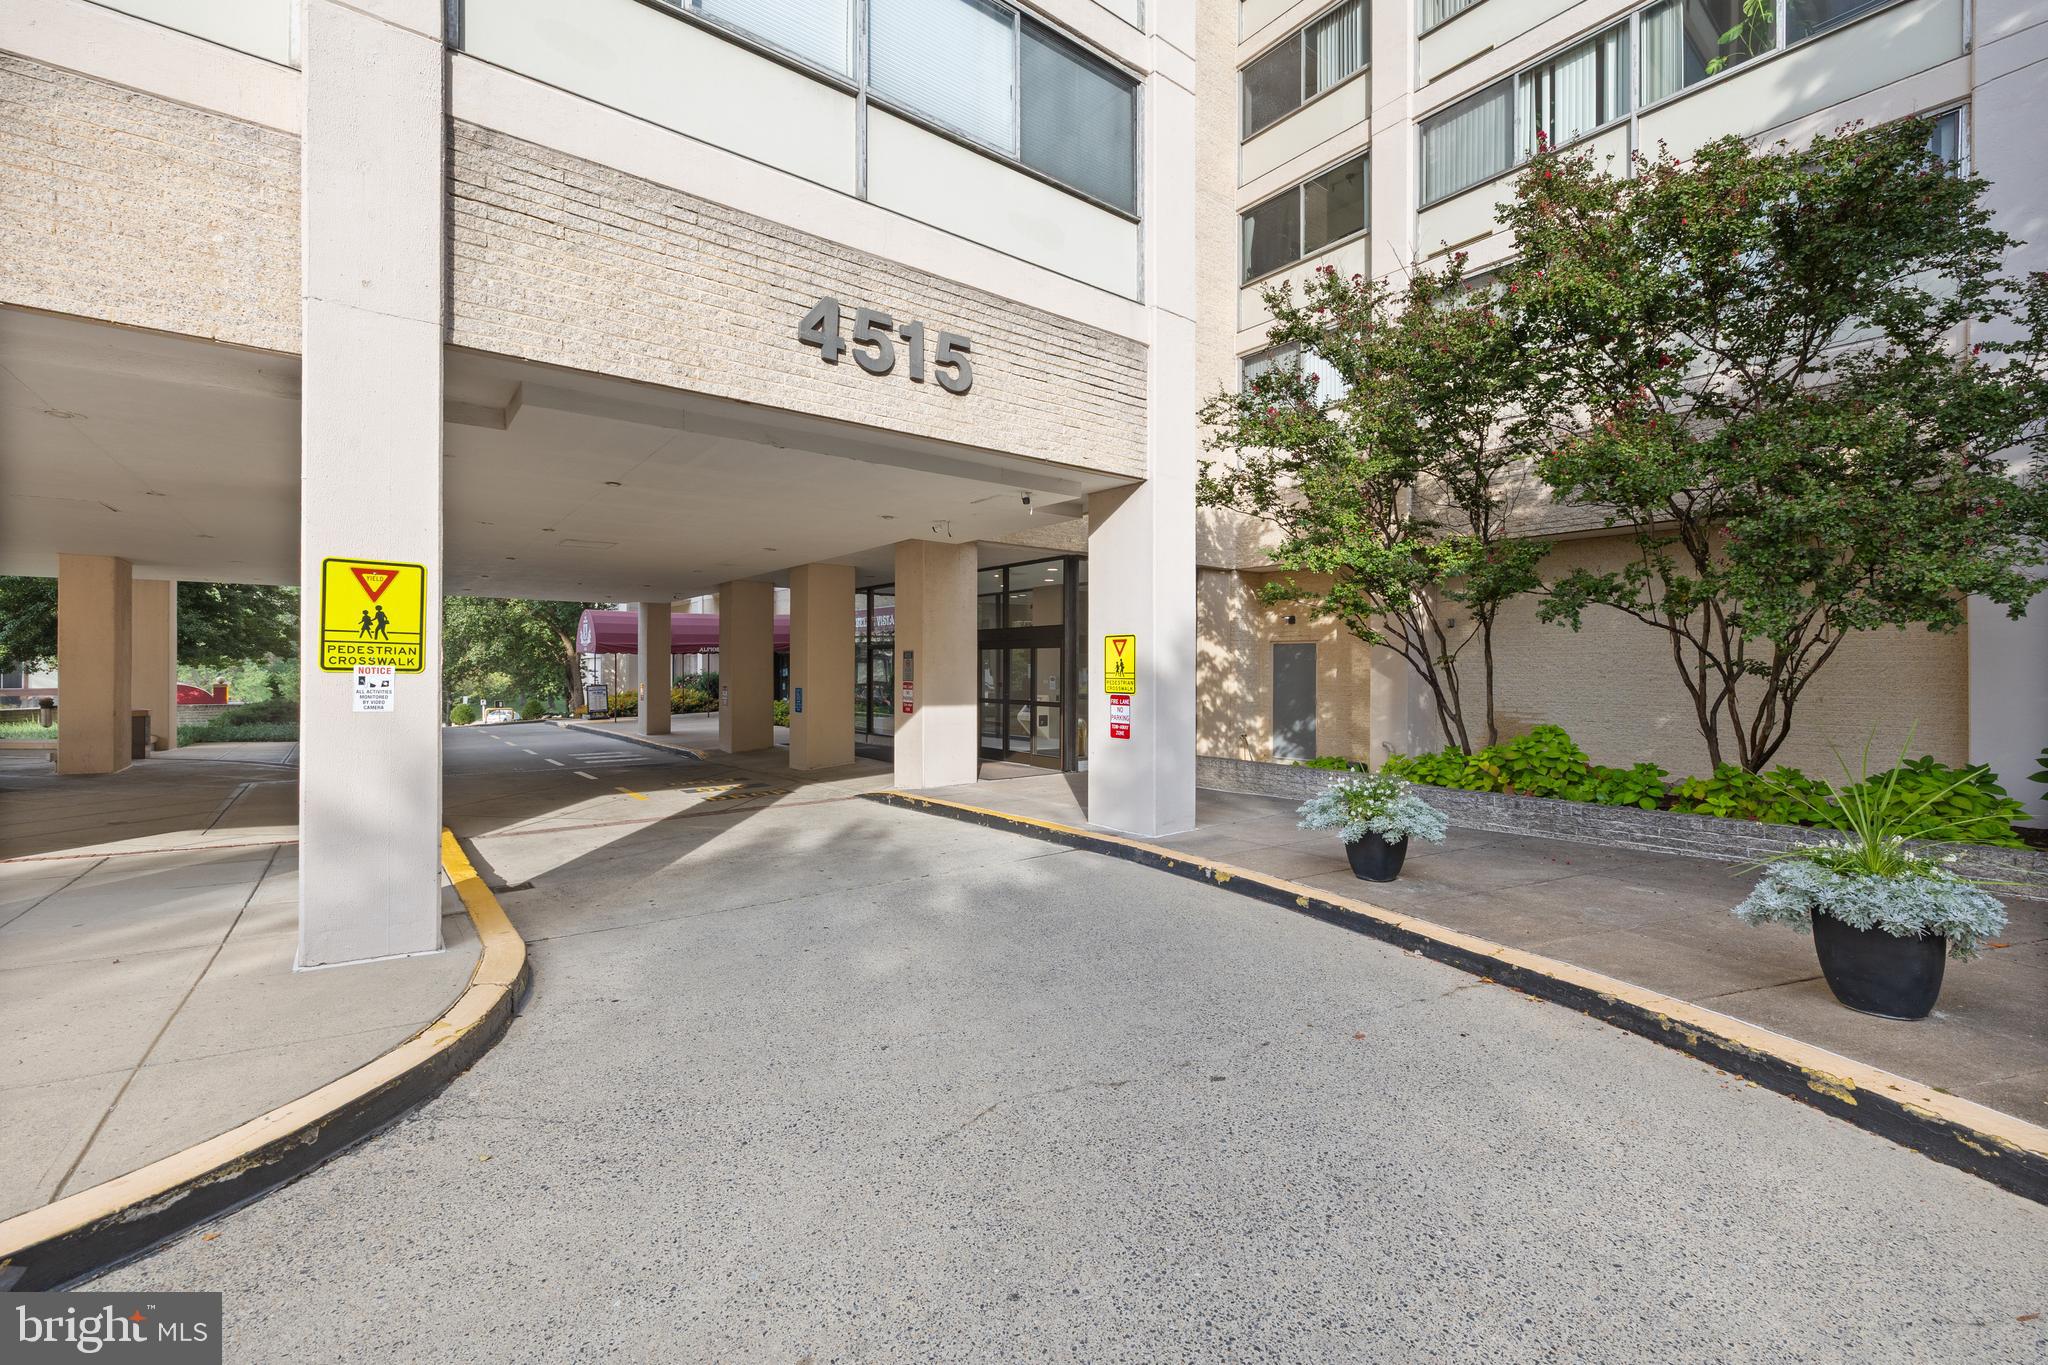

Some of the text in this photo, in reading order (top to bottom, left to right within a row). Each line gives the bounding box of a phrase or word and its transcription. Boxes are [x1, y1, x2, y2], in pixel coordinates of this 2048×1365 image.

[798, 296, 973, 396] 4515
[327, 645, 417, 655] PEDESTRIAN
[328, 656, 415, 666] CROSSWALK
[358, 666, 392, 675] NOTICE
[1111, 714, 1130, 722] PARKING
